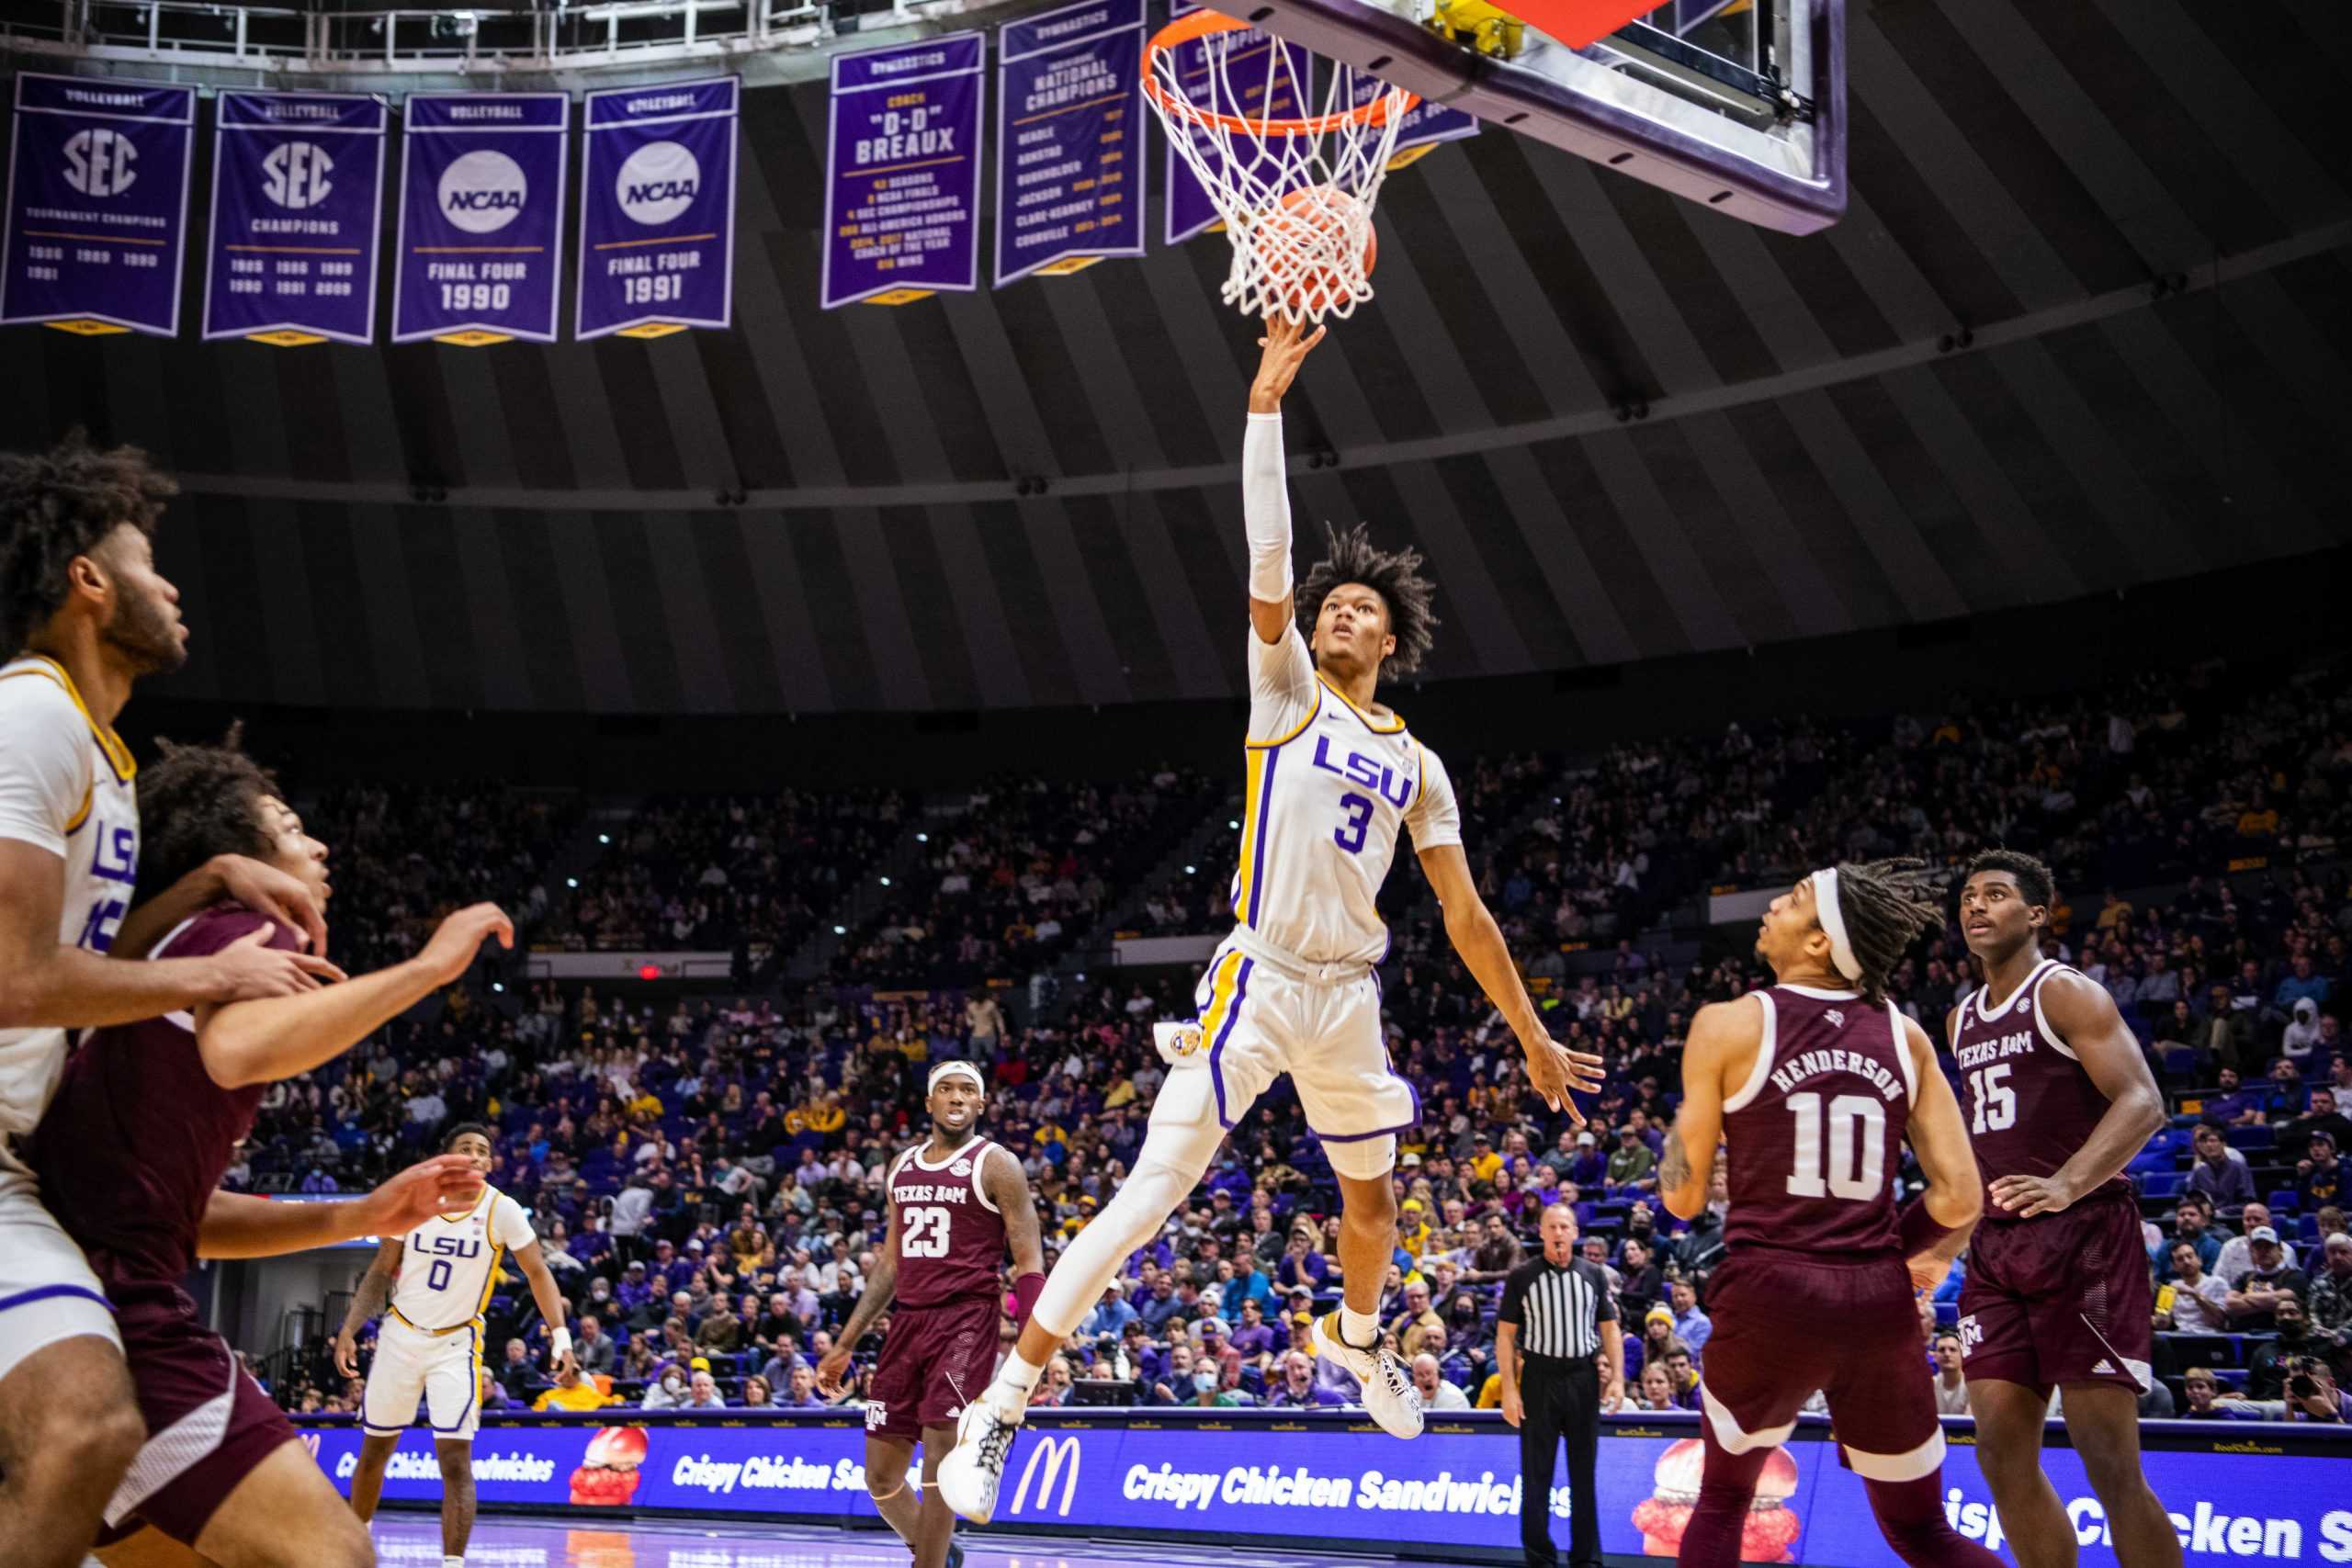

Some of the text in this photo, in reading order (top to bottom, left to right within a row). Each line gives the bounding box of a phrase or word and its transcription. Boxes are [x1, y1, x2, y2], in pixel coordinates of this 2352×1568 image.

[1036, 10, 1108, 39] GYMNASTICS
[871, 52, 945, 74] GYMNASTICS
[1035, 59, 1108, 92] NATIONAL
[65, 89, 145, 107] VOLLEYBALL
[627, 94, 696, 113] VOLLEYBALL
[887, 93, 925, 108] COACH
[1026, 73, 1118, 111] CHAMPIONS
[266, 104, 340, 120] VOLLEYBALL
[450, 106, 523, 119] VOLLEYBALL
[855, 128, 955, 164] BREAUX
[62, 129, 138, 197] SEC
[262, 141, 334, 209] SEC
[447, 191, 521, 210] NCAA
[626, 179, 696, 205] NCAA
[1016, 186, 1063, 208] JACKSON
[27, 208, 165, 228] TOURNAMENT CHAMPIONS
[252, 219, 339, 235] CHAMPIONS
[428, 262, 526, 279] FINAL FOUR
[608, 251, 700, 276] FINAL FOUR
[441, 284, 511, 310] 1990
[625, 275, 681, 305] 1991
[1313, 735, 1413, 808] LSU
[1334, 792, 1374, 854] 3
[1958, 1031, 2035, 1069] TEXAS A&M
[1770, 1049, 1904, 1102] HENDERSON
[1969, 1063, 2016, 1134] 15
[1786, 1092, 1886, 1201] 10
[893, 1185, 967, 1204] TEXAS A&M
[413, 1233, 481, 1258] LSU
[901, 1206, 951, 1258] 23
[427, 1259, 452, 1292] 0
[672, 1453, 742, 1494] Crispy
[740, 1455, 832, 1489] Chicken
[1123, 1462, 1221, 1510] Crispy
[1220, 1465, 1353, 1507] Chicken
